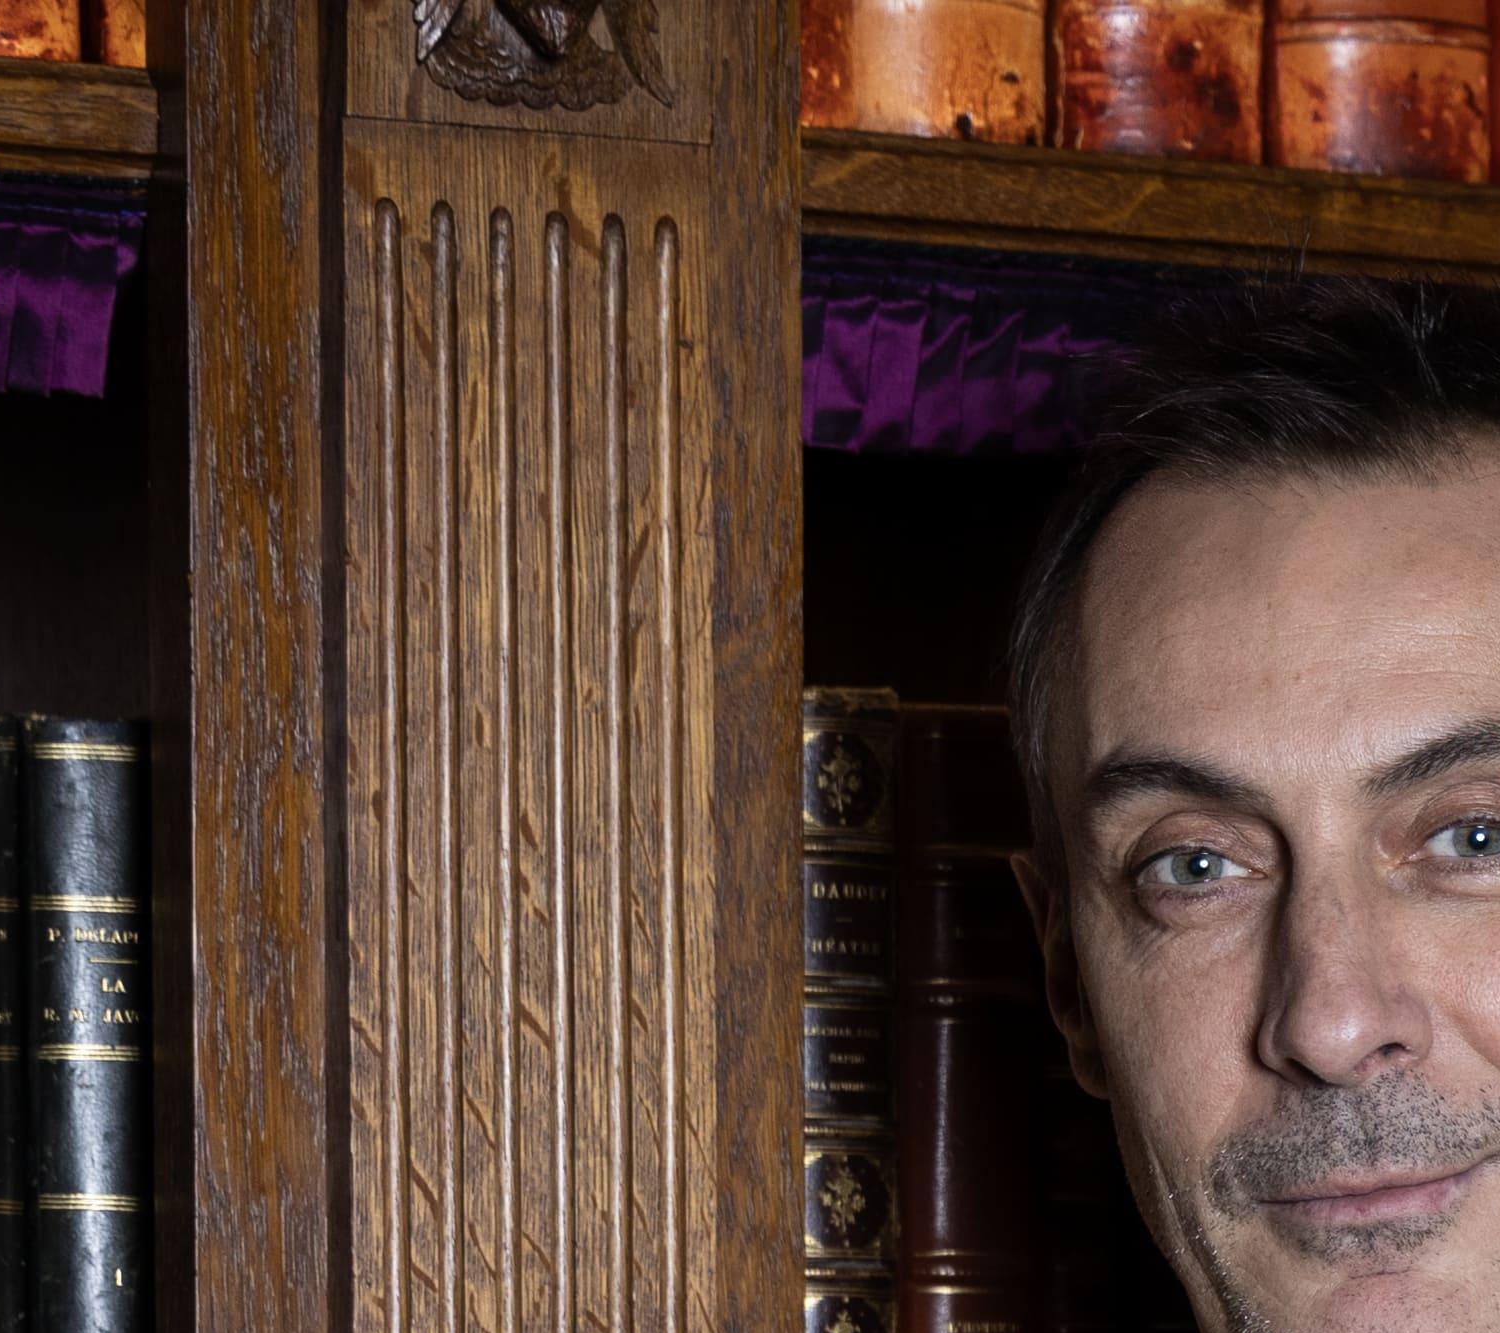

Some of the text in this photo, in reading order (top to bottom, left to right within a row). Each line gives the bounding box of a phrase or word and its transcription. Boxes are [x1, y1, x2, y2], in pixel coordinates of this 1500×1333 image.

[47, 926, 66, 943] P.
[101, 977, 127, 994] LA
[43, 1008, 60, 1023] R.
